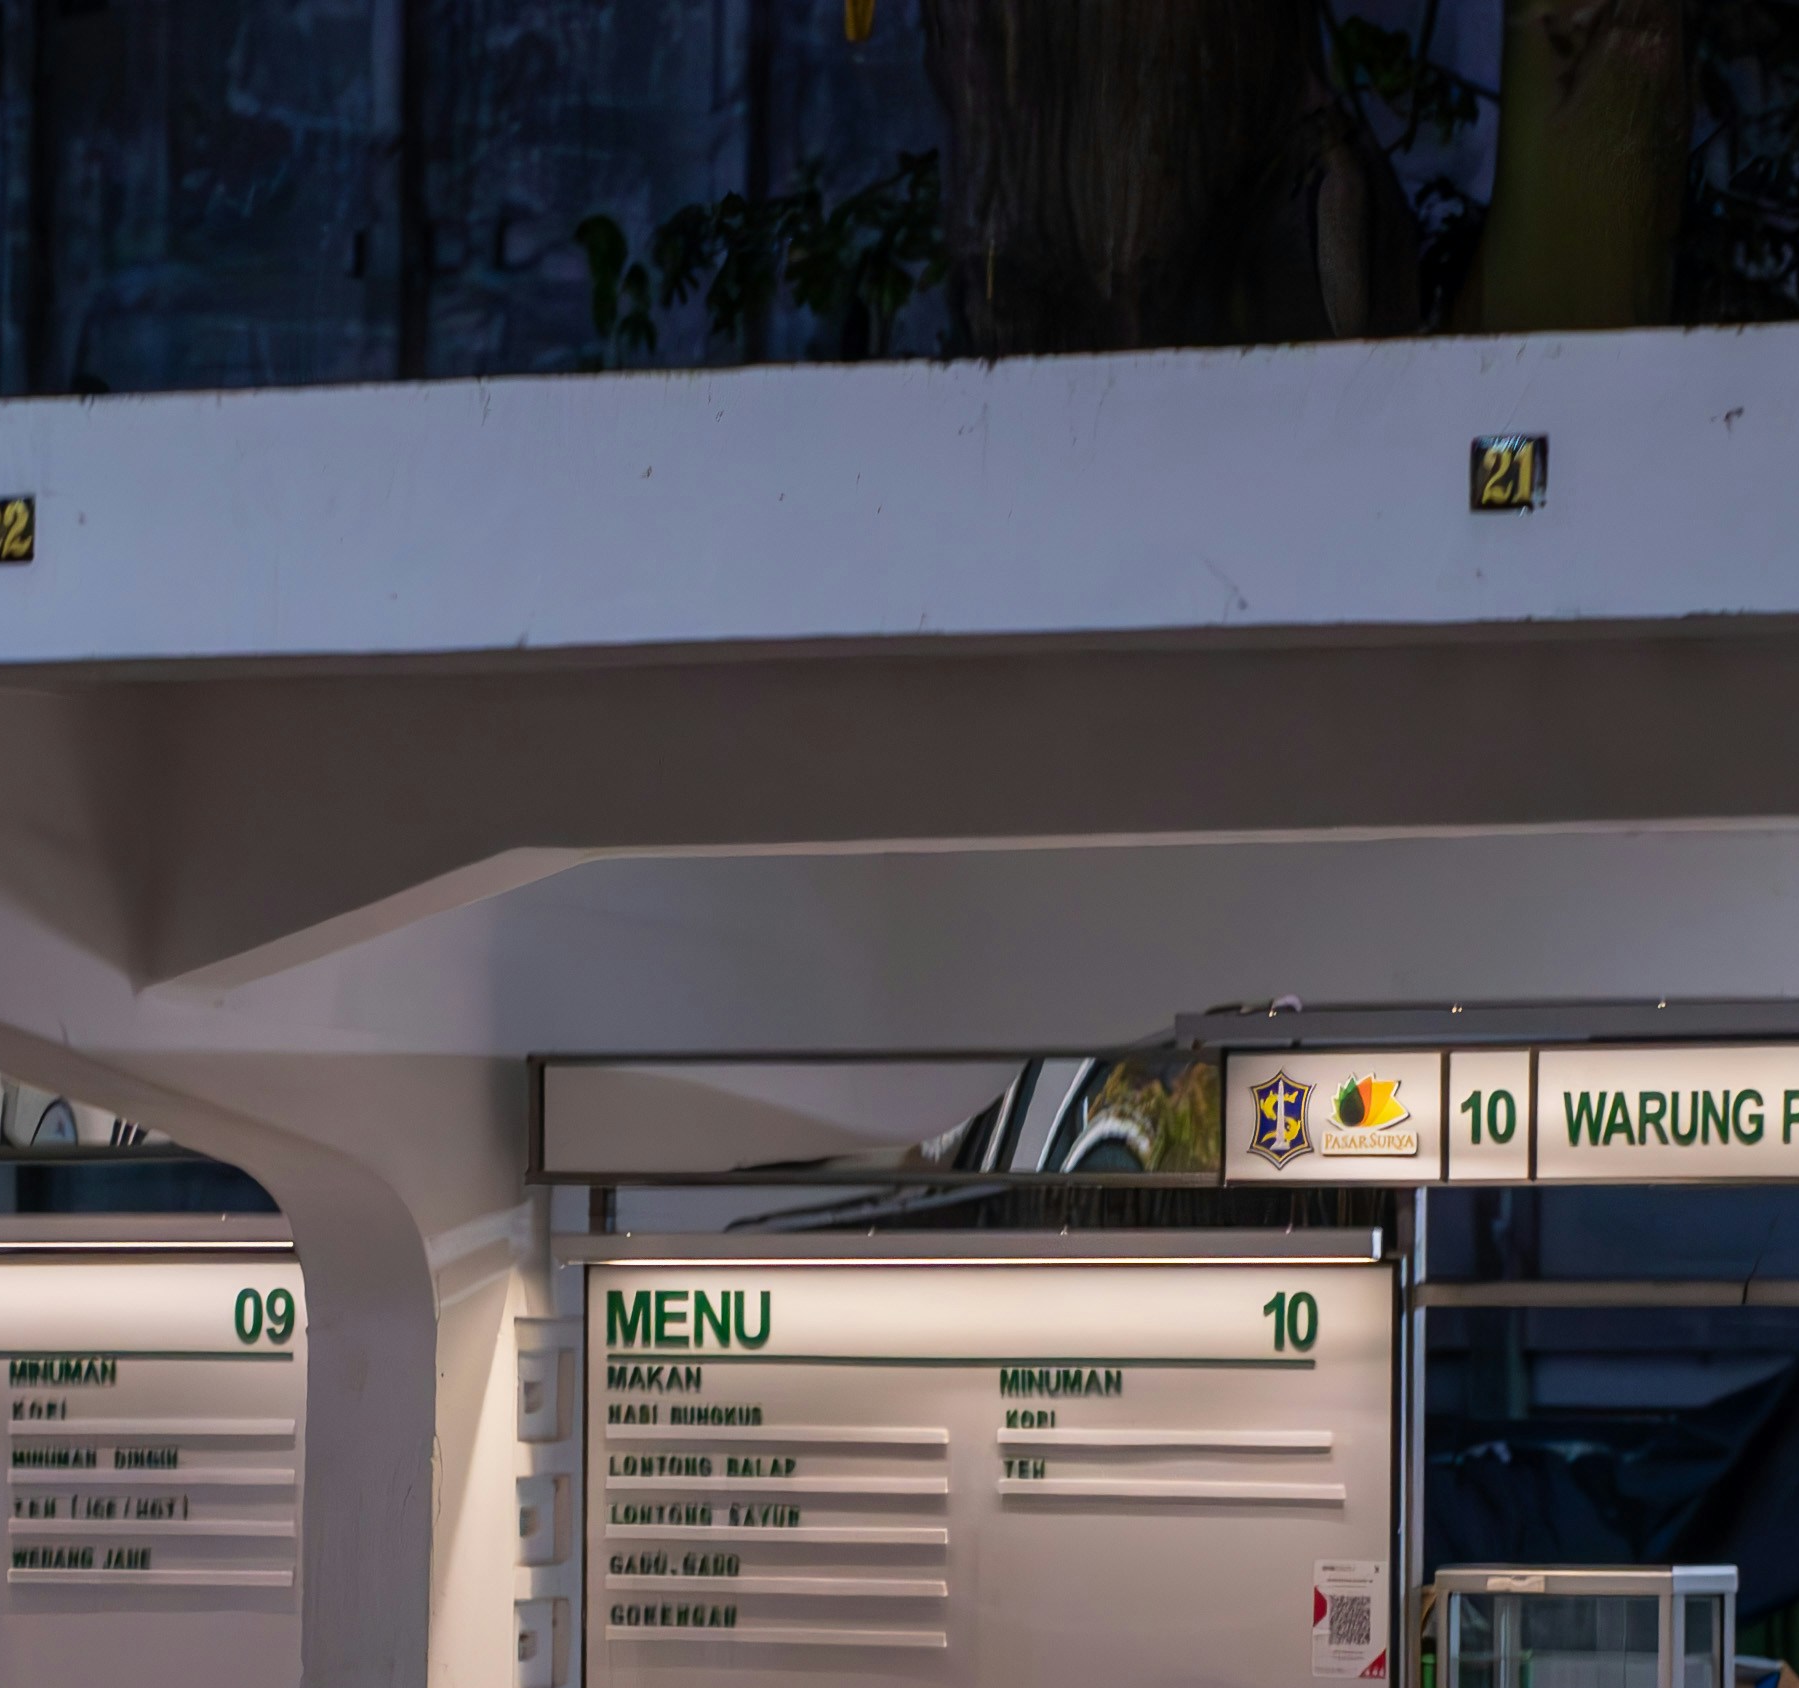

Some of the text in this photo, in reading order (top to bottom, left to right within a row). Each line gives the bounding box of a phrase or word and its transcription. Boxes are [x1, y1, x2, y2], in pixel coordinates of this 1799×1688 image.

[1481, 440, 1535, 505] 21
[1460, 1089, 1518, 1144] 10
[1563, 1088, 1766, 1145] WARUNG
[234, 1287, 295, 1344] 09
[606, 1290, 1319, 1350] MENU 10
[9, 1359, 118, 1387] MINUMAN
[606, 1366, 702, 1393] MAKAN
[1000, 1368, 1122, 1397] MINUMAN
[1005, 1409, 1056, 1429] KOPI
[609, 1456, 713, 1478] LONTONG
[1003, 1458, 1046, 1479] TEH
